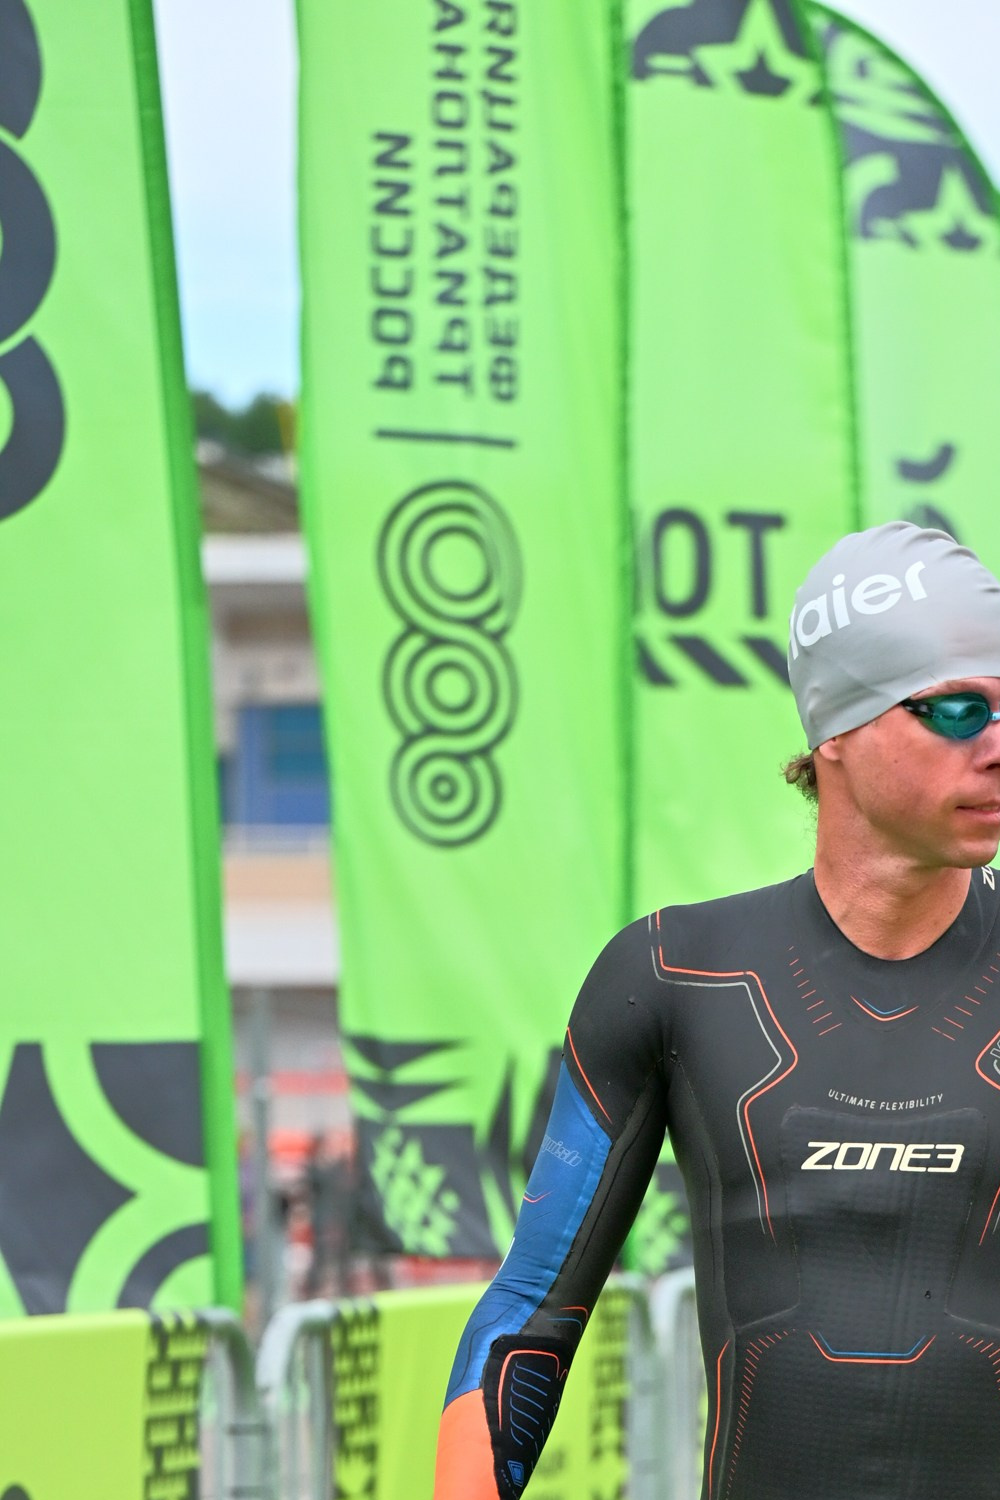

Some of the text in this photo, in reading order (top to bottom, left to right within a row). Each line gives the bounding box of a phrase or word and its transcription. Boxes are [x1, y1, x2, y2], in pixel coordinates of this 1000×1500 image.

[828, 1088, 944, 1111] ULTIMATE FLEXIBILITY
[801, 1141, 965, 1173] ZONE3
